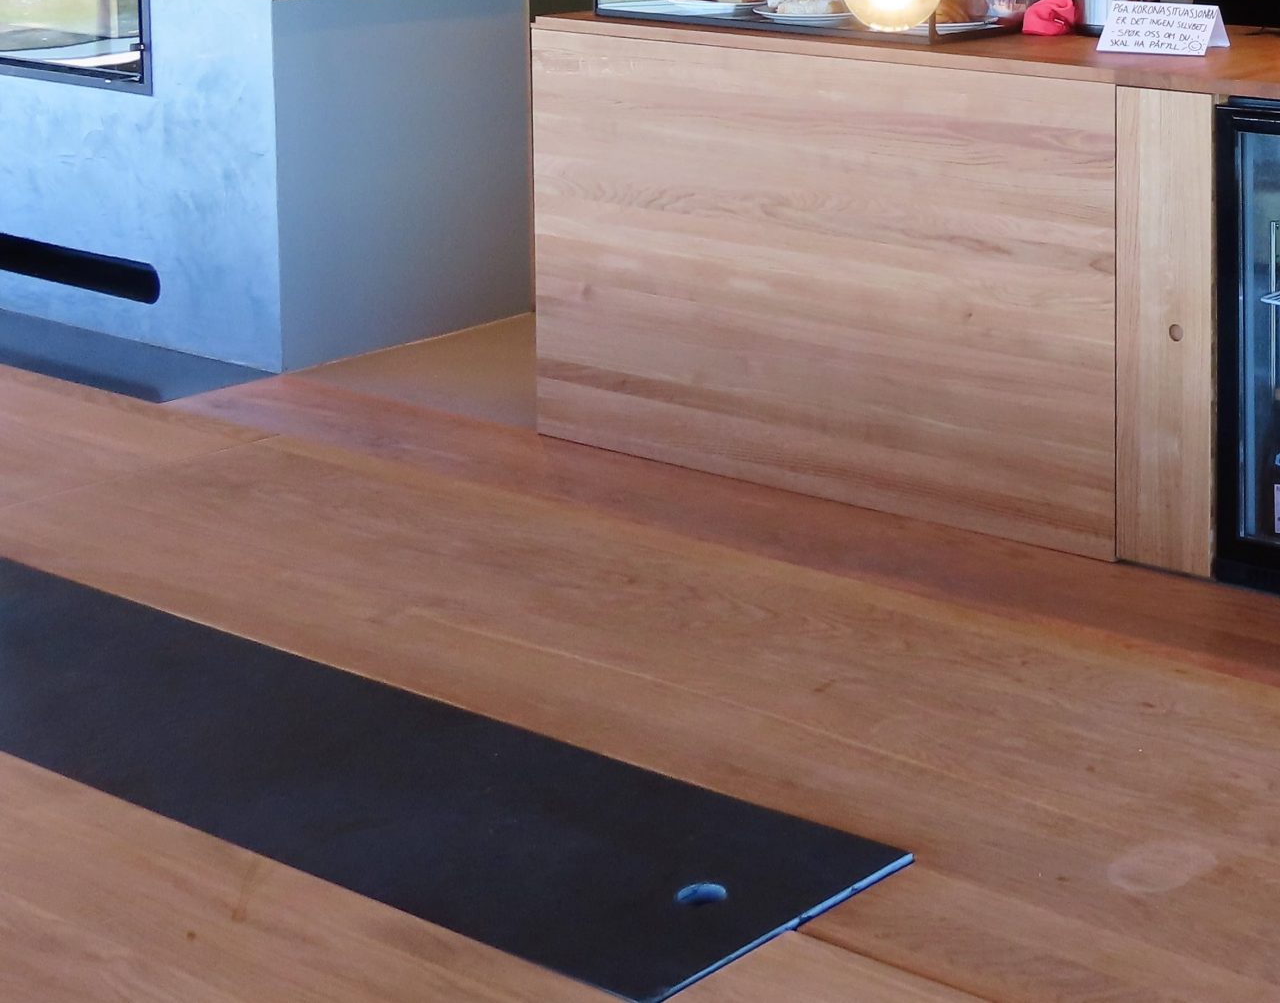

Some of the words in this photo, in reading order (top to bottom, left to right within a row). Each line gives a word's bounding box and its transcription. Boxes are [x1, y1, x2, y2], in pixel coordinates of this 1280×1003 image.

[1113, 3, 1128, 13] PGA
[1130, 17, 1148, 25] DET
[1149, 18, 1174, 28] INGEN
[1144, 30, 1160, 38] OSS
[1110, 39, 1129, 47] SKAL
